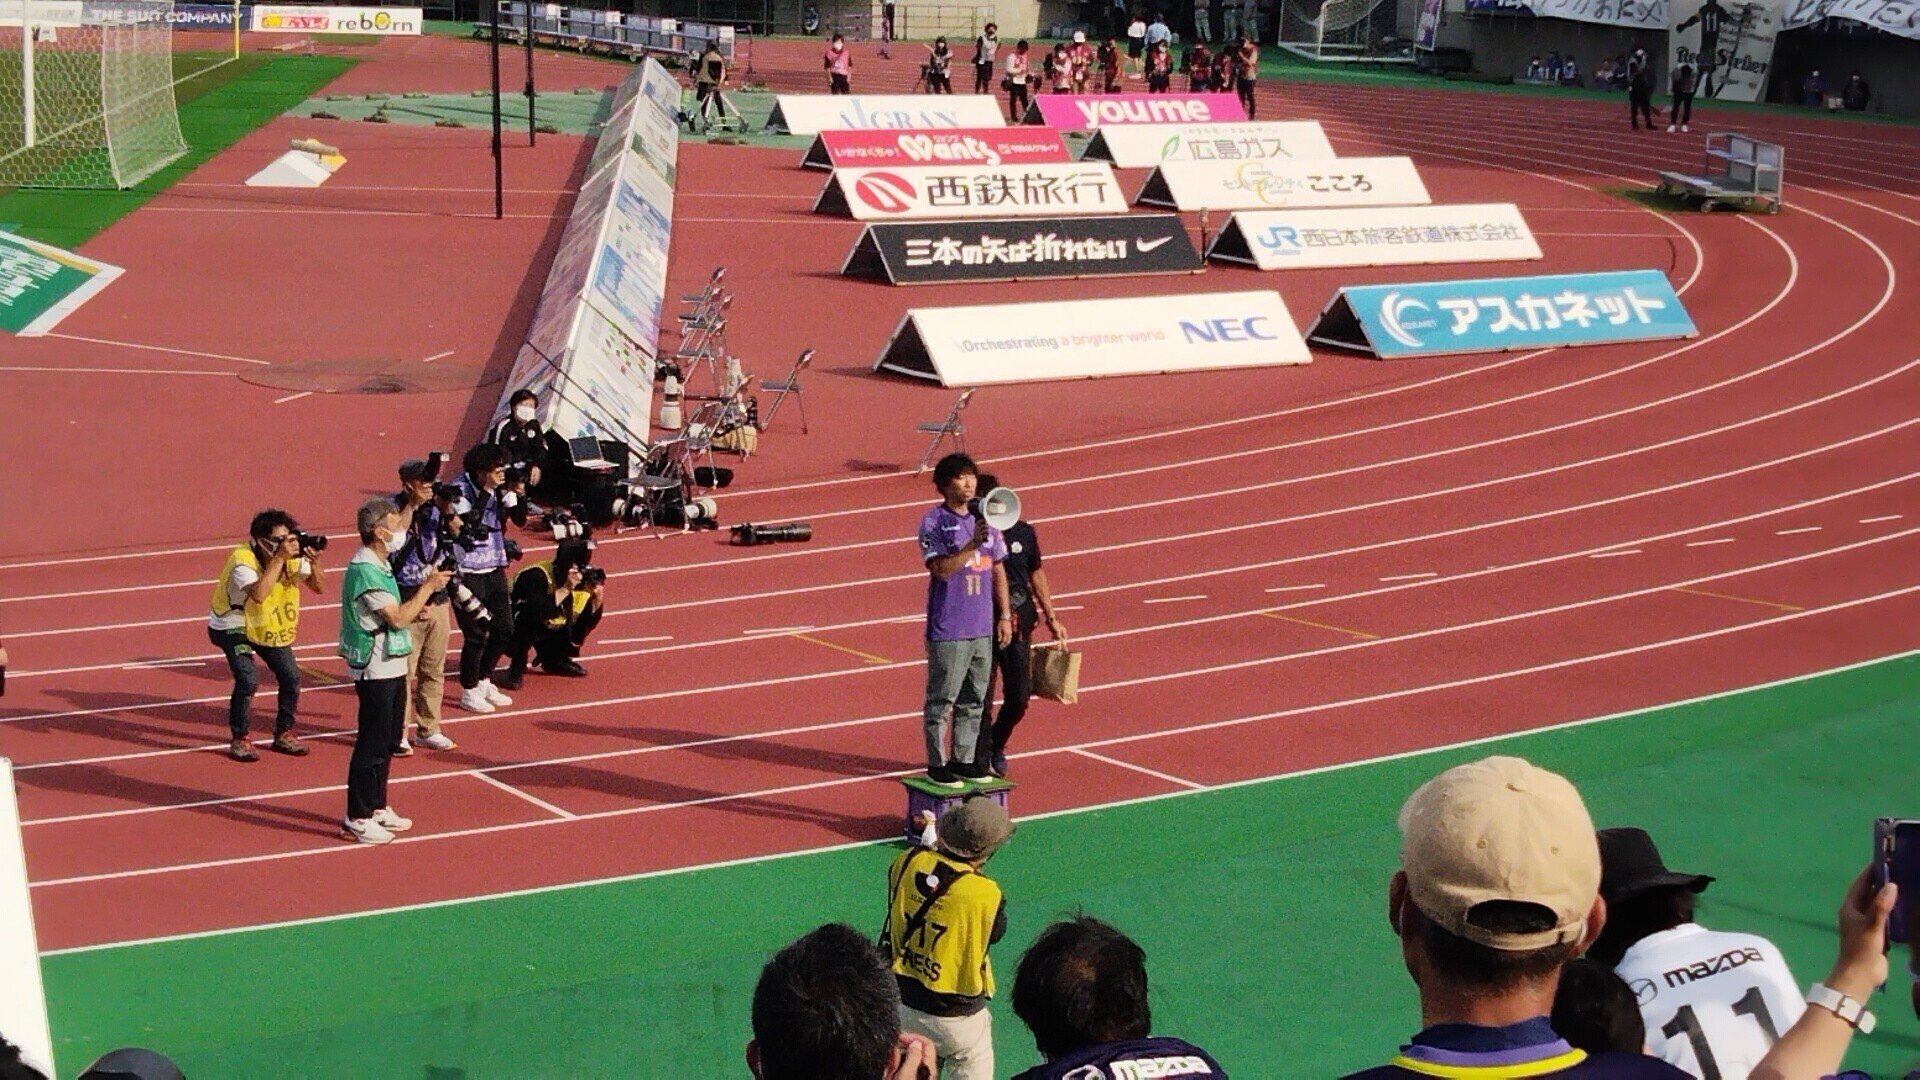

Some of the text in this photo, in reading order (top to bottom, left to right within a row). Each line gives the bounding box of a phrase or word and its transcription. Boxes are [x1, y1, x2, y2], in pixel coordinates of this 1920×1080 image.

[165, 11, 243, 24] COMPANY
[1075, 99, 1210, 129] youme
[897, 133, 1001, 166] Wants
[1187, 137, 1294, 161] 広島ガス
[924, 171, 1108, 207] 西鉄旅行
[1306, 173, 1374, 193] こころ
[905, 233, 1127, 266] 三本の矢は折れない
[1258, 226, 1302, 249] JR
[1436, 287, 1667, 336] アスカネット
[1178, 315, 1279, 345] NEC
[962, 335, 1060, 354] Orchestrating
[1061, 338, 1070, 347] a
[966, 574, 981, 596] 11
[272, 602, 297, 627] 16
[1663, 947, 1765, 988] mazda
[1661, 985, 1780, 1080] 11
[1109, 1056, 1213, 1080] mazda
